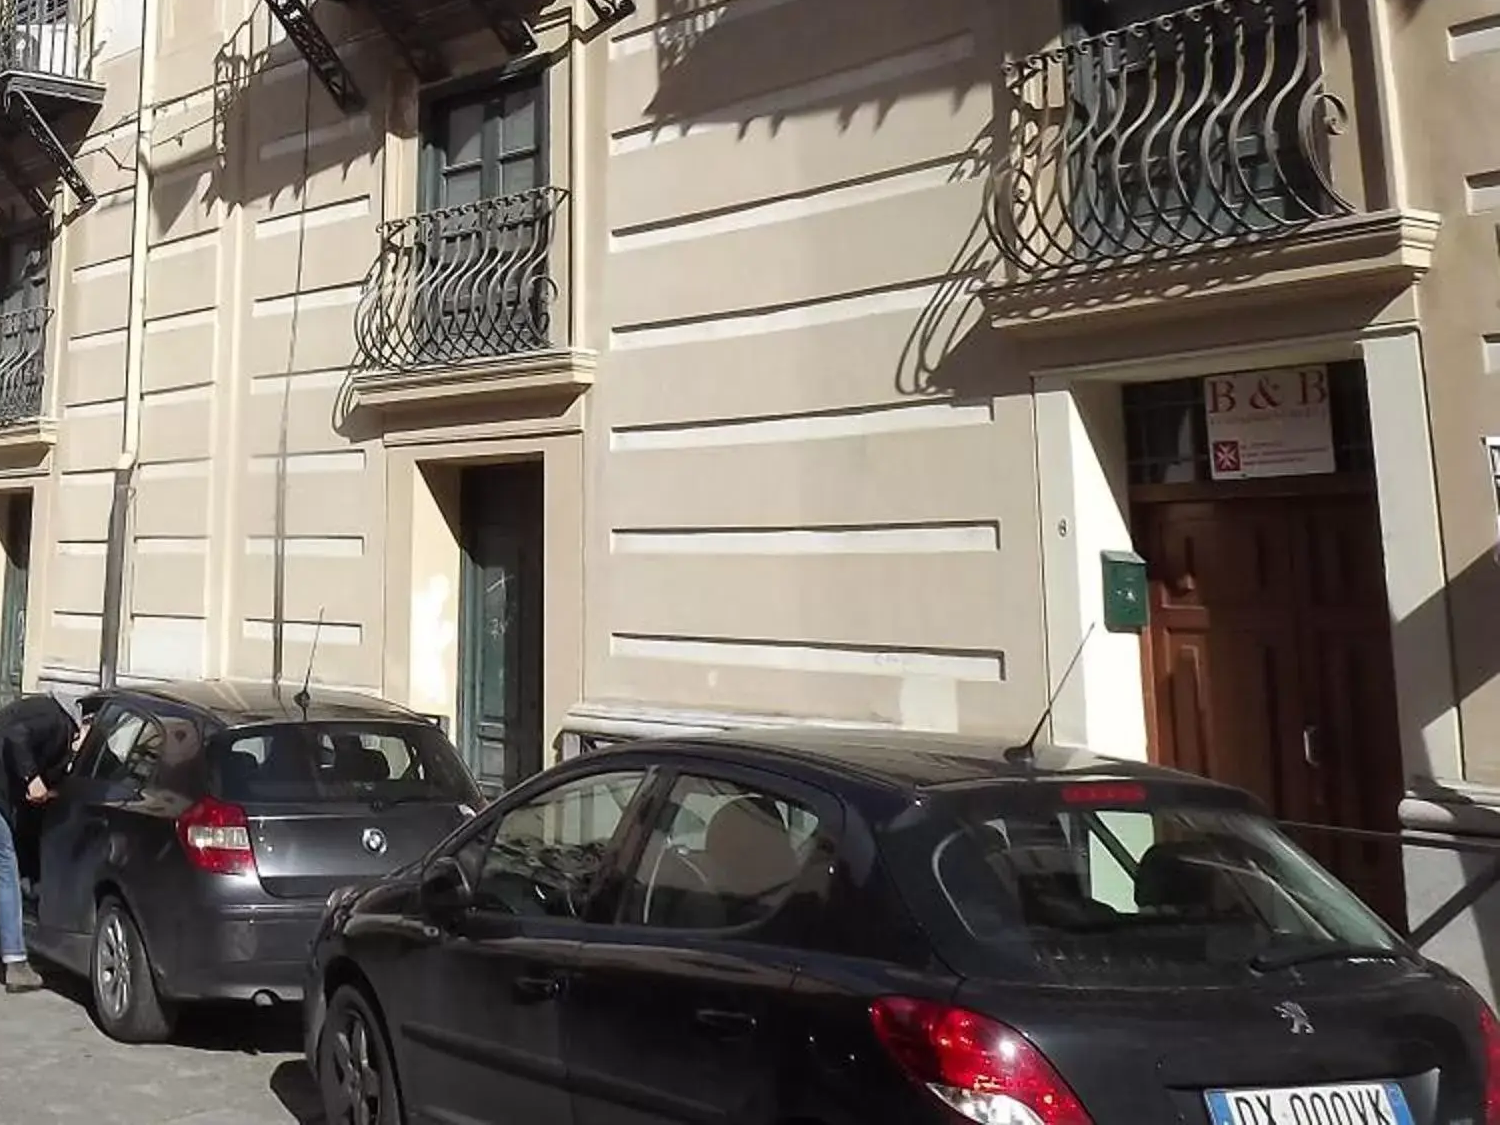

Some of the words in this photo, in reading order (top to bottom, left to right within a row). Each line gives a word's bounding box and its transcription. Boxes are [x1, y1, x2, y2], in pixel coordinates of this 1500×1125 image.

[1208, 378, 1237, 414] B
[1249, 375, 1284, 410] &
[1297, 370, 1328, 406] B
